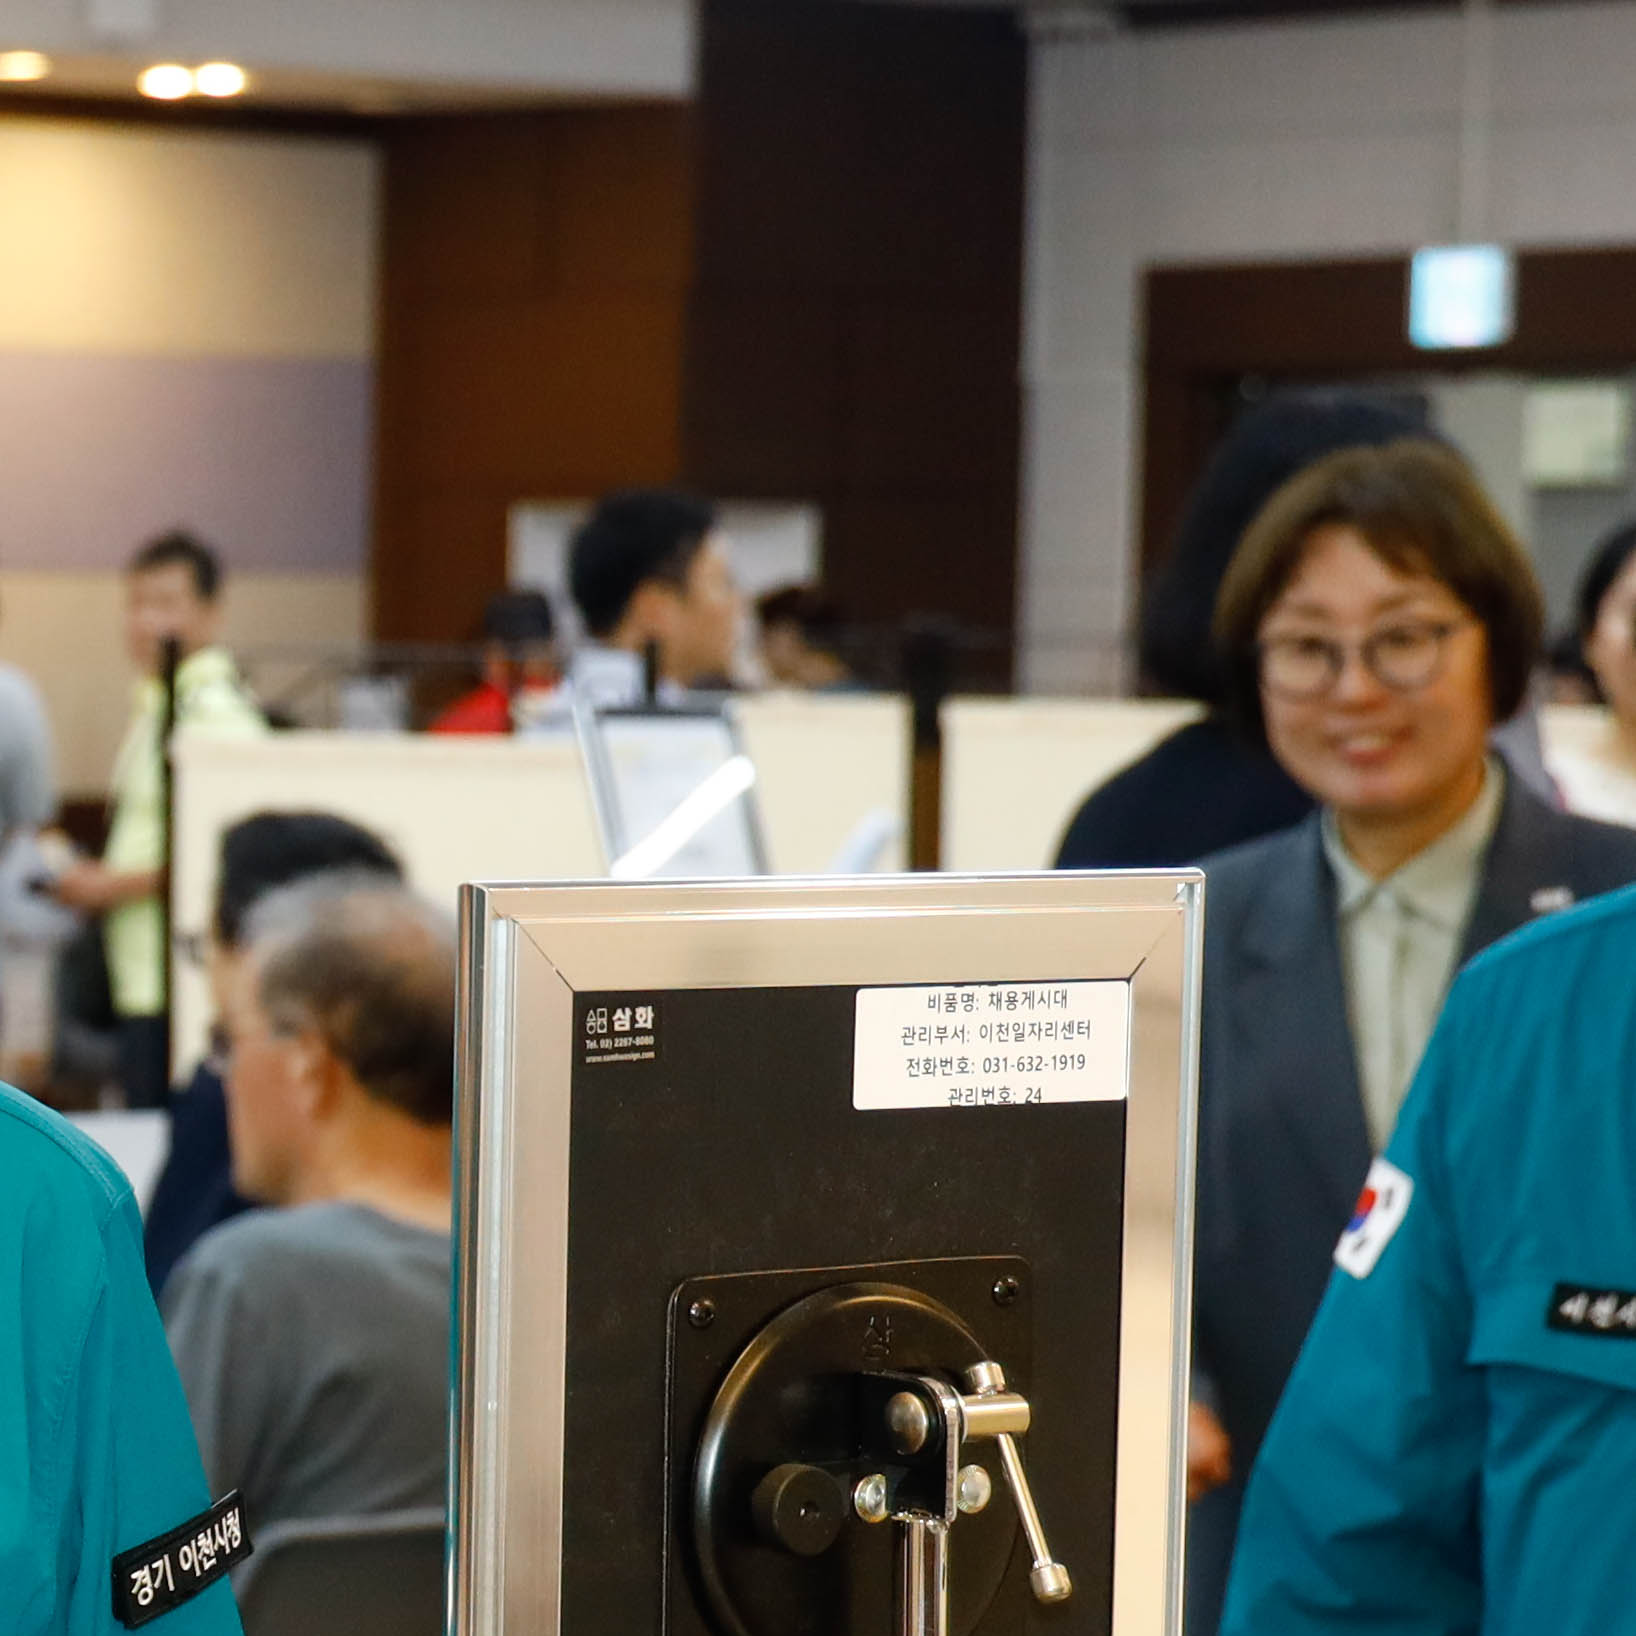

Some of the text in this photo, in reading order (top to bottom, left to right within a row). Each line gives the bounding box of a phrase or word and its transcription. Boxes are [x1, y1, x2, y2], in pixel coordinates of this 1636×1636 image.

[927, 988, 1068, 1014] 비품명: 채용게시대
[611, 1005, 655, 1032] 삼화
[900, 1019, 1092, 1047] 관리부서: 이천일자리센터
[905, 1053, 1087, 1078] 전화번호: 031-632-1919
[947, 1086, 1043, 1107] 관리번호: 24
[130, 1505, 242, 1606] 경기 이천시청
